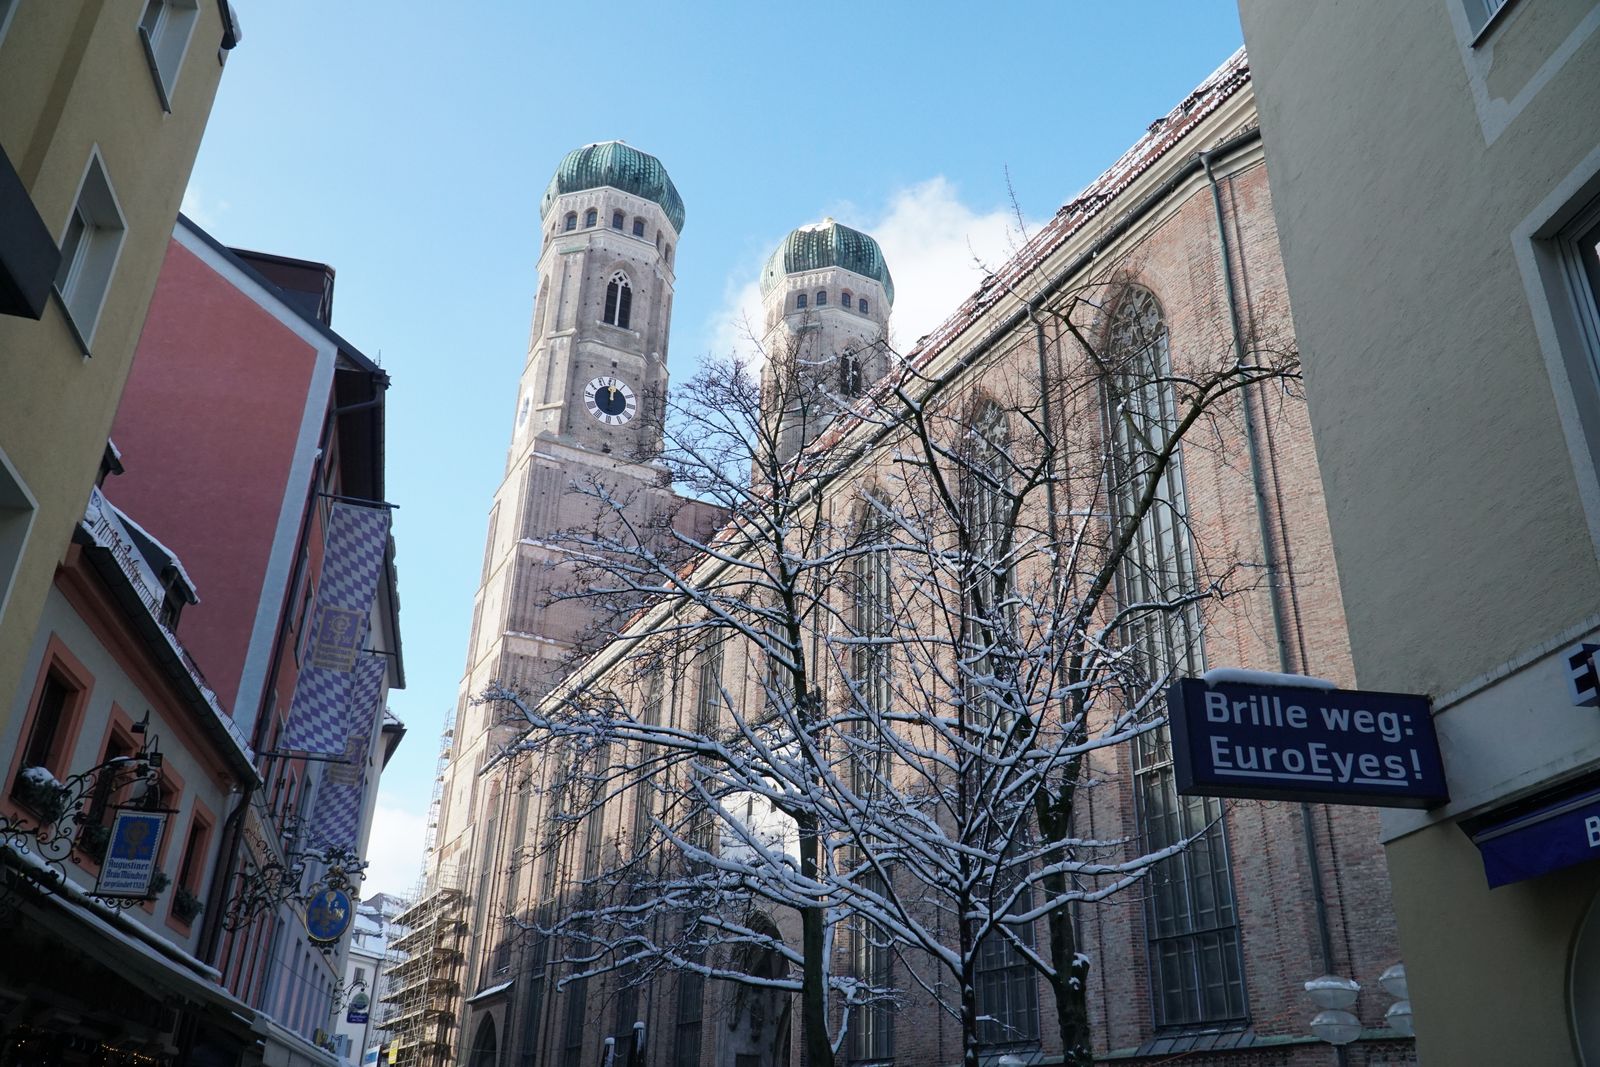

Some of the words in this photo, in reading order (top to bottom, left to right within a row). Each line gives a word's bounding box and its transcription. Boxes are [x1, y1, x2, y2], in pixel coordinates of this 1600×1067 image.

[1203, 691, 1308, 730] Brille
[1319, 707, 1415, 743] weg:
[1209, 735, 1423, 783] EuroEyes!
[107, 859, 150, 871] Augustiner
